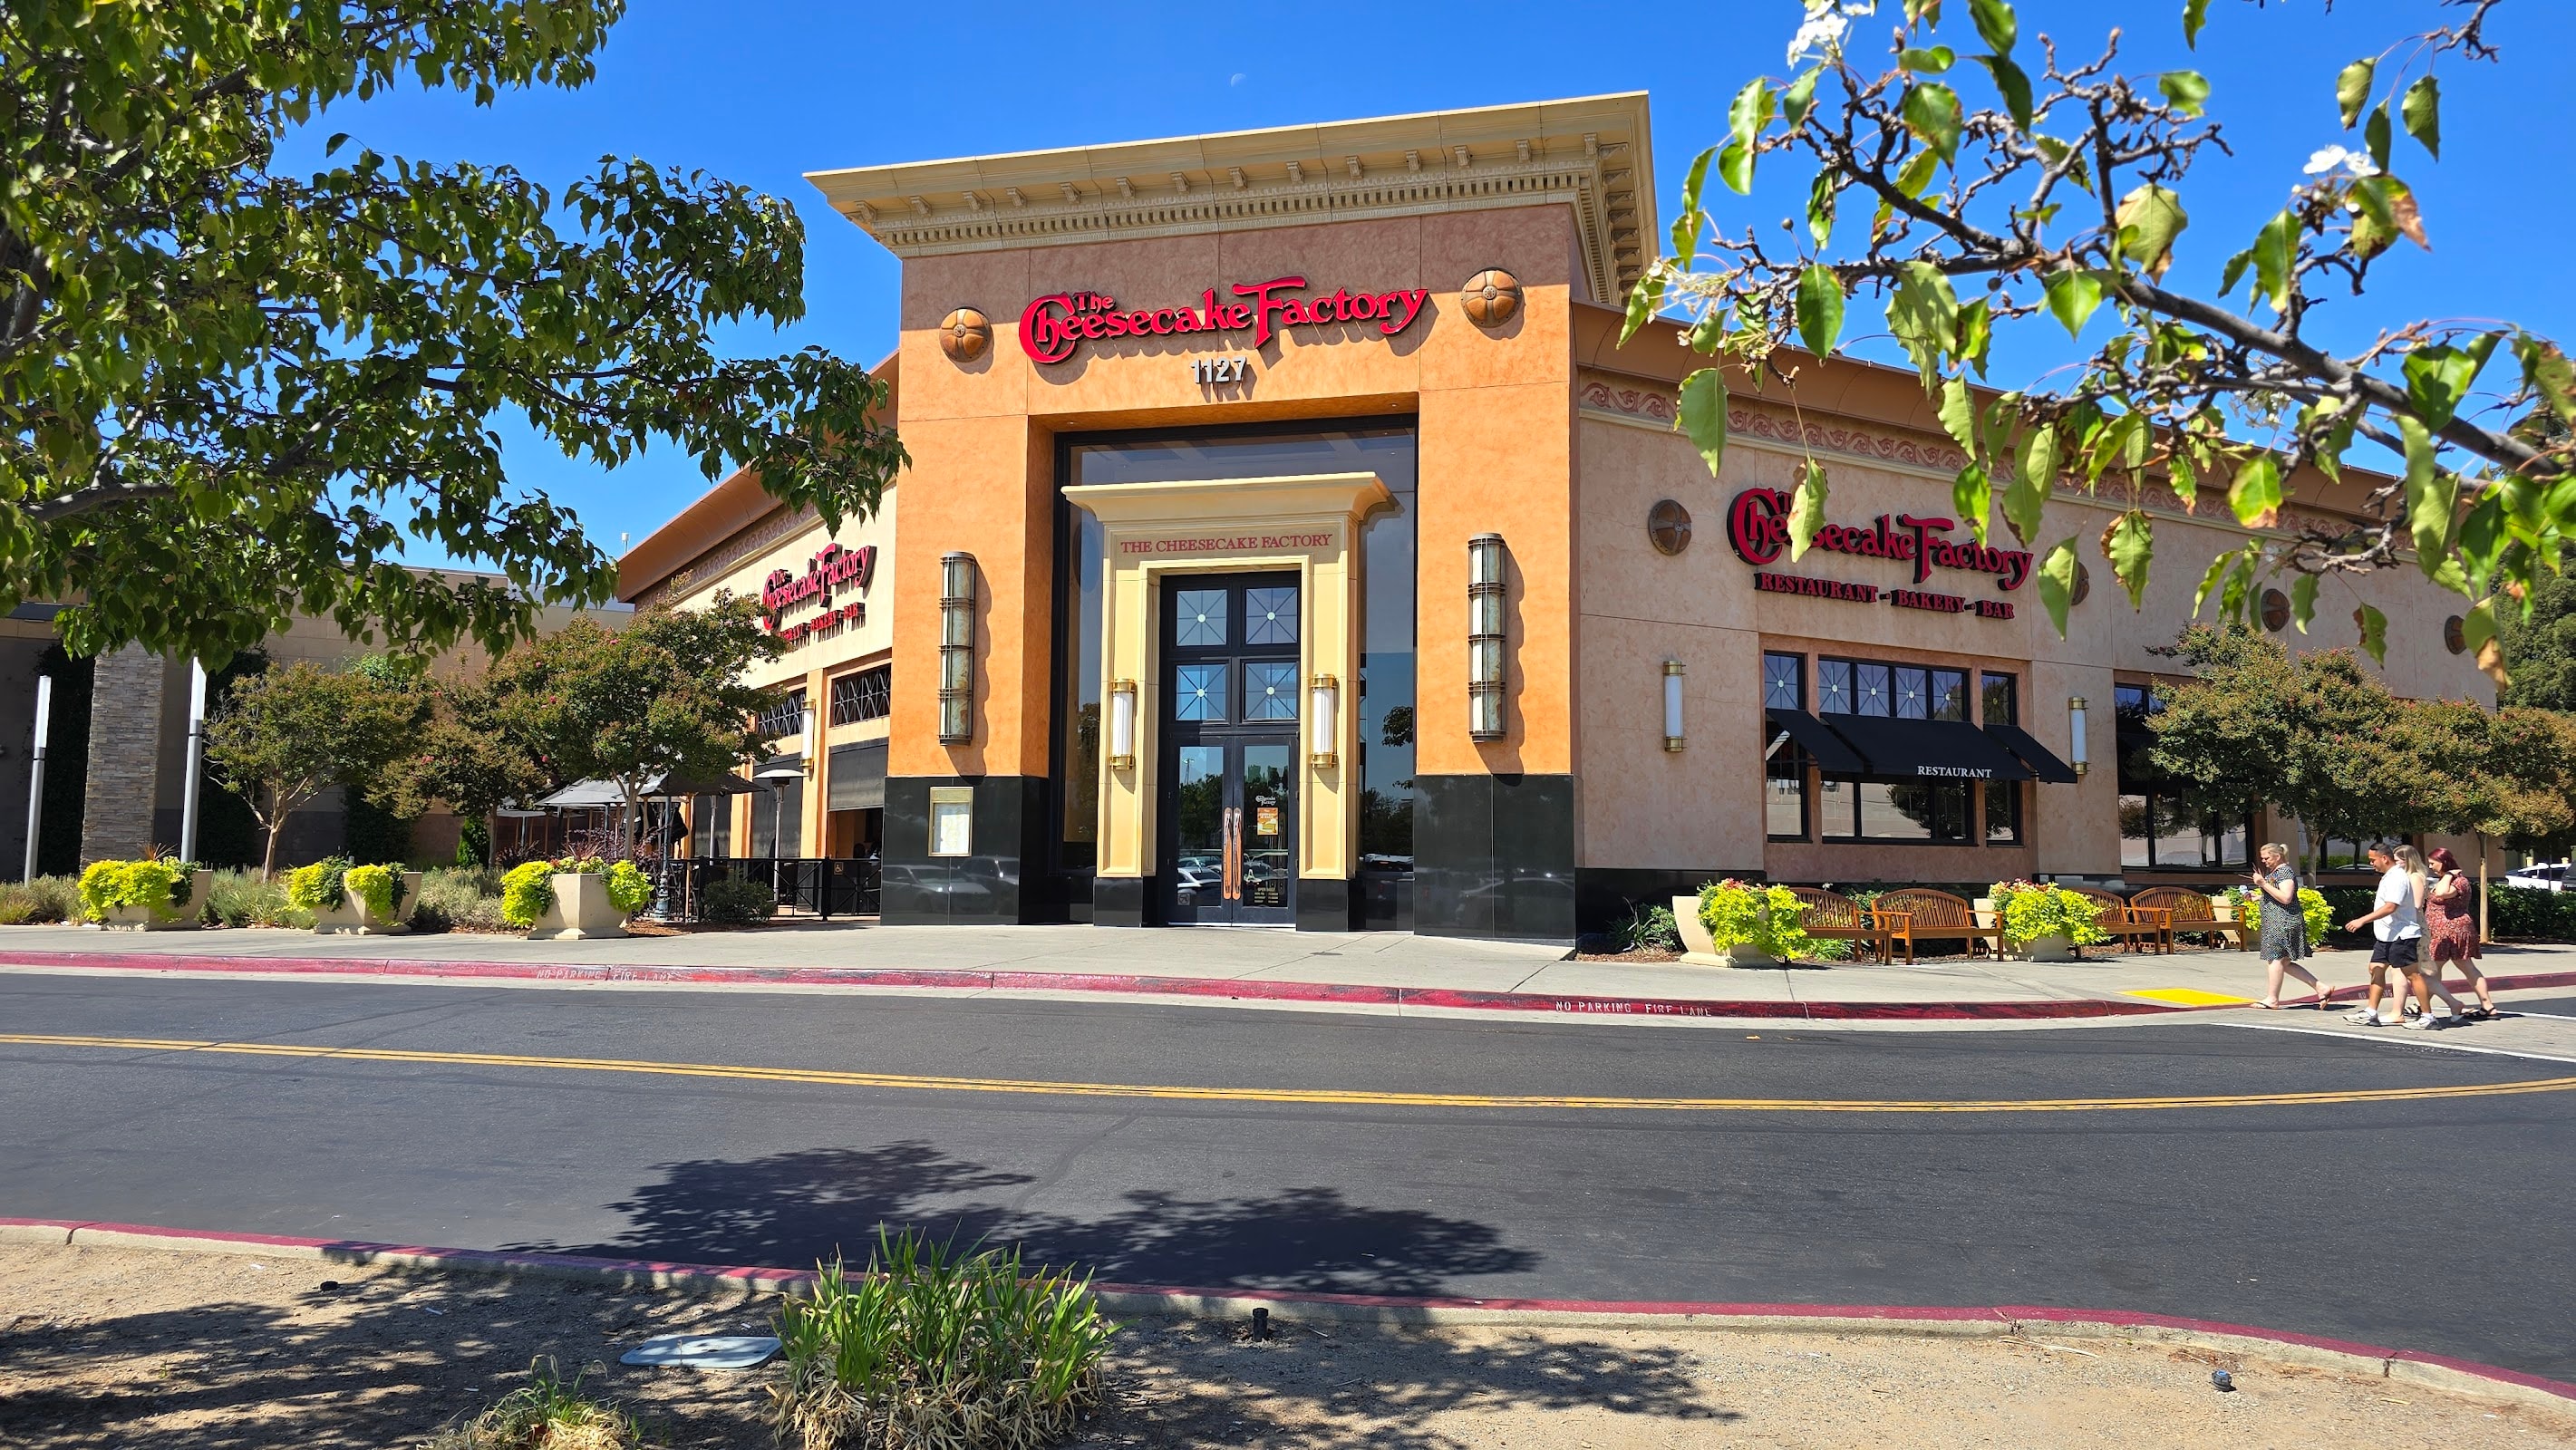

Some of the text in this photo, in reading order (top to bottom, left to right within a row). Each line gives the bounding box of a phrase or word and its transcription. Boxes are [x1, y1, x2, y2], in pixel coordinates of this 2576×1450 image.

[1073, 291, 1116, 314] The
[1018, 276, 1428, 363] Cheesecake Factory
[1189, 355, 1247, 384] 1127
[1120, 533, 1333, 554] THE CHEESECAKE FACTORY
[1729, 487, 2034, 591] Cheecake Factory
[815, 542, 874, 606] Factory
[1758, 572, 2015, 620] RESTAURANT BAKERY BAR
[1917, 765, 1992, 778] RESTAURANT
[1555, 1000, 1572, 1011] NO
[1578, 1000, 1632, 1013] PARKING
